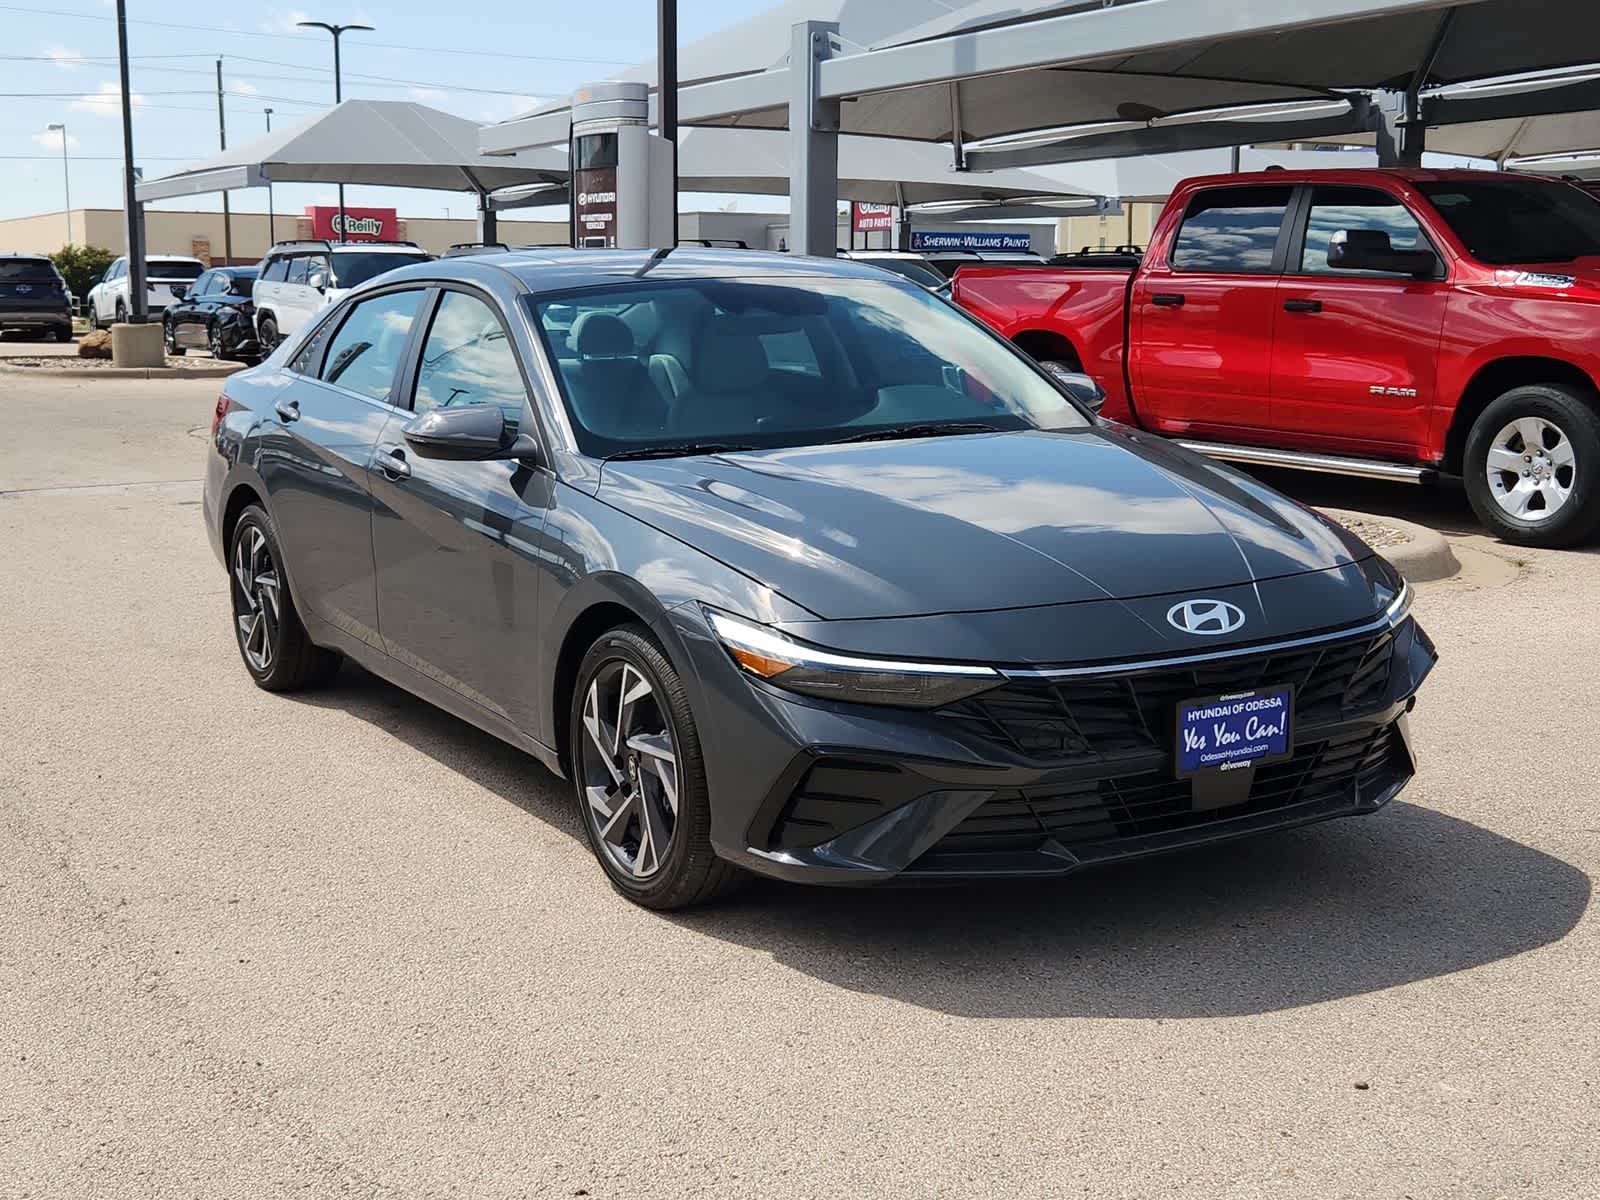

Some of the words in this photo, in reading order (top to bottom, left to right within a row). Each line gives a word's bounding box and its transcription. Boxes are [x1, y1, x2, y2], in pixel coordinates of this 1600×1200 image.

[587, 192, 616, 203] HYUNDAI
[859, 219, 873, 228] AUTO
[874, 217, 891, 227] PARTS
[923, 235, 1001, 247] SHERWIN-WILLIAMS
[1003, 237, 1030, 248] PAINTS
[1370, 385, 1416, 397] RAM
[1187, 705, 1231, 721] HYUNDAI
[1232, 703, 1245, 714] OF
[1245, 697, 1282, 712] ODESSA
[1183, 727, 1207, 752] Yes
[1213, 721, 1240, 747] You
[1245, 711, 1286, 741] Can!
[1200, 744, 1269, 762] OdessaHyundai.com
[1220, 760, 1252, 771] driveway
